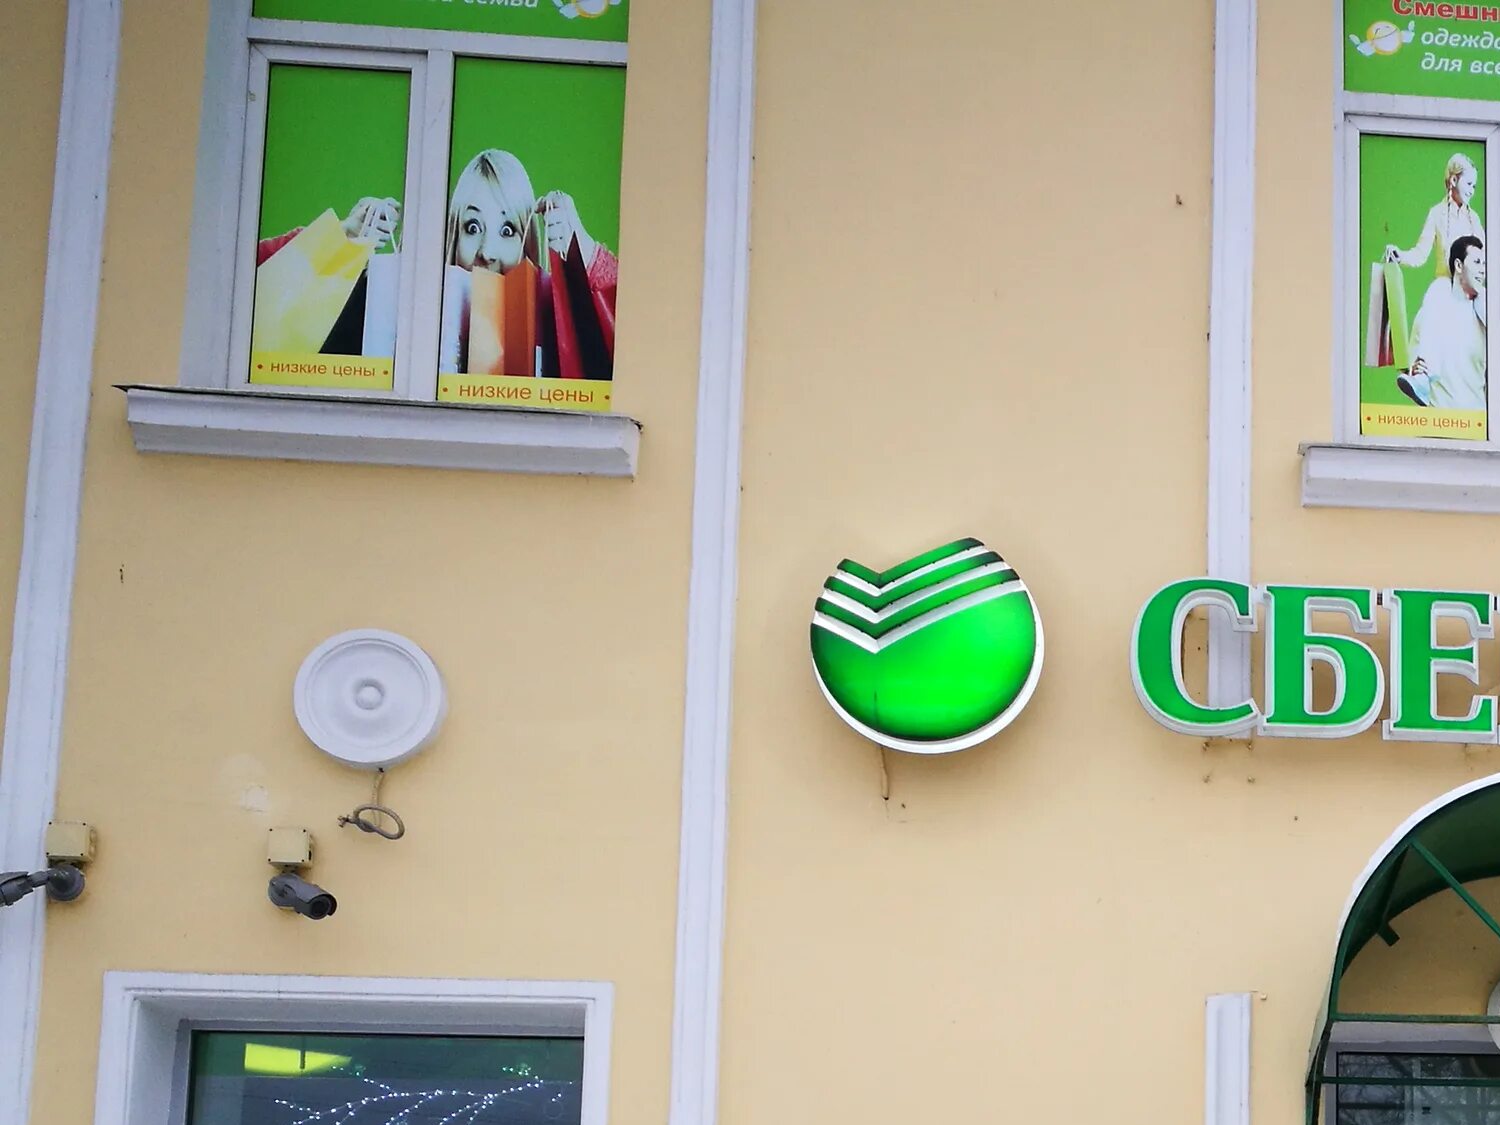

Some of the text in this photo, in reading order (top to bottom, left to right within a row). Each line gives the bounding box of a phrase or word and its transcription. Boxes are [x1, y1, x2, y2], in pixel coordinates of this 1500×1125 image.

[1420, 53, 1463, 75] для
[270, 362, 376, 378] низкие цены
[459, 384, 594, 403] низкие цены
[1378, 415, 1471, 429] низкие цены
